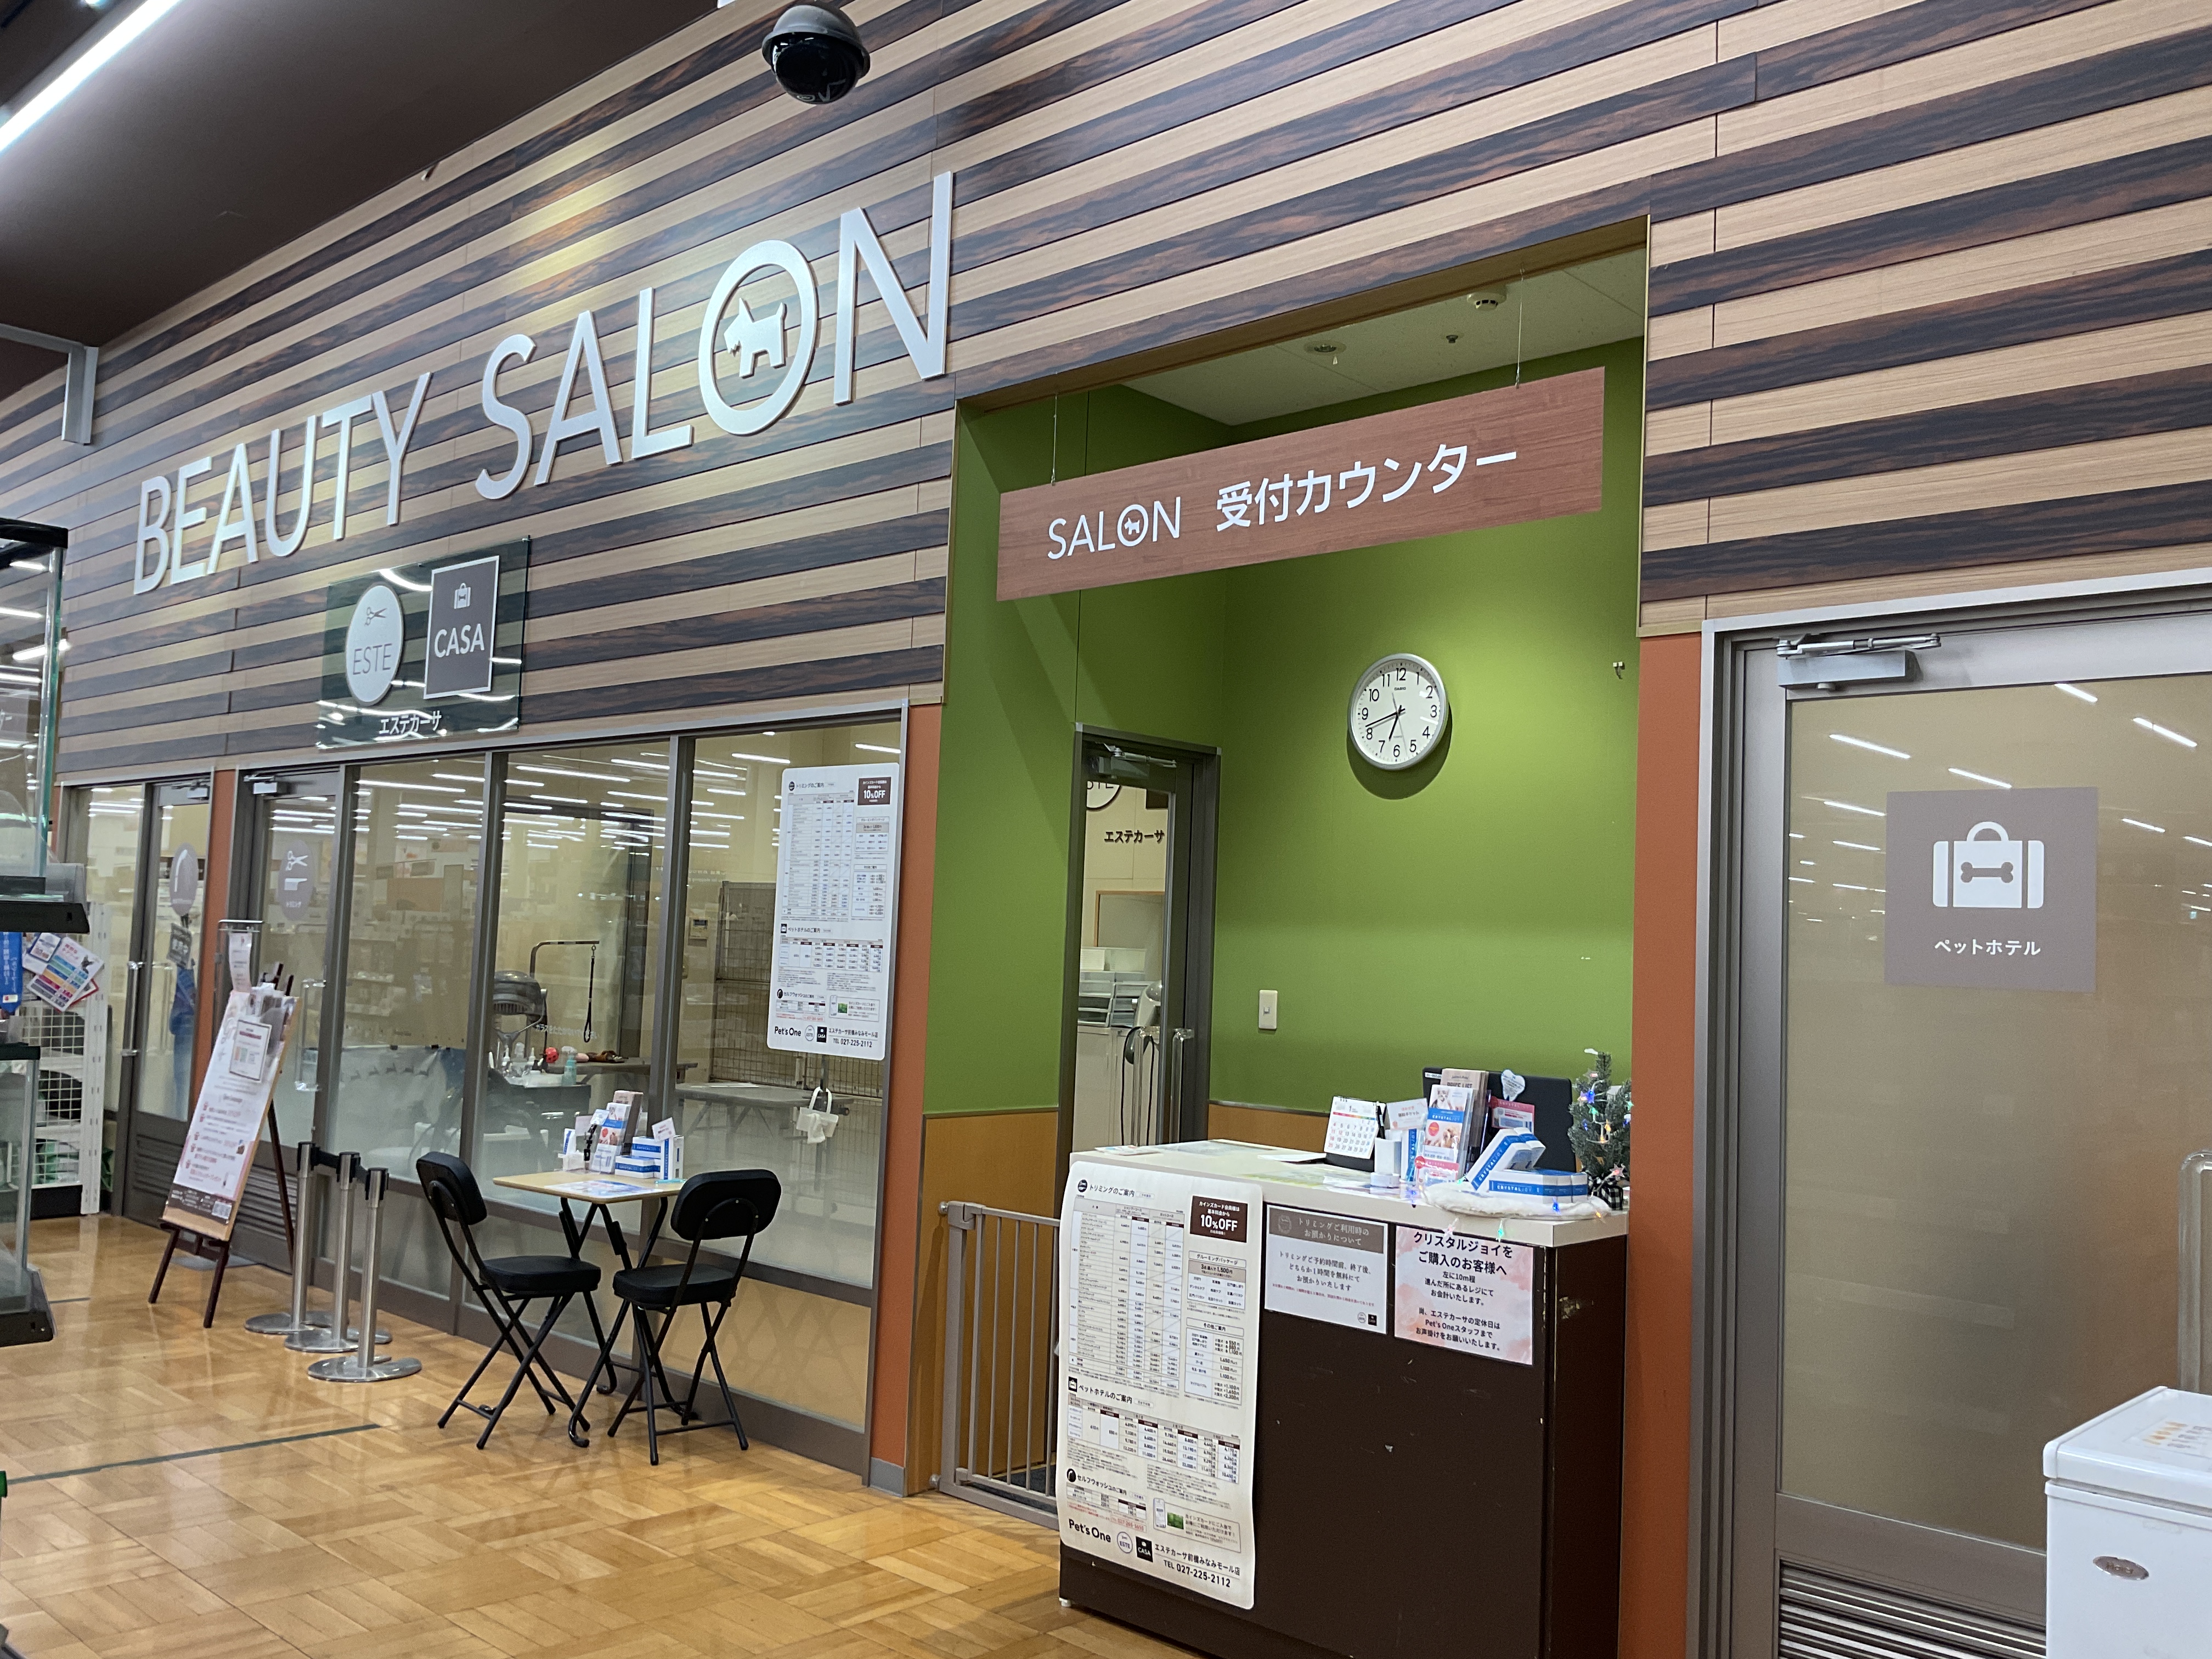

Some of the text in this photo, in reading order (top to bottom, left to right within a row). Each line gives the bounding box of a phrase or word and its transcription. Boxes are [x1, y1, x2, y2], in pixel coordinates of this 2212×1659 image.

[134, 171, 952, 595] BEAUTY SALON
[1047, 443, 1517, 560] SALON 受付カウンター
[435, 623, 485, 658] CASA
[353, 643, 393, 675] ESTE
[1383, 674, 1390, 687] 11
[1396, 668, 1406, 681] 12
[1417, 672, 1419, 685] 1
[1369, 689, 1379, 702] 10
[1426, 686, 1432, 698] 2
[1362, 708, 1368, 720] 9
[1431, 705, 1437, 718] 3
[379, 710, 441, 735] エステカーサ
[1367, 727, 1373, 740] 8
[1423, 726, 1430, 738] 4
[1379, 741, 1385, 753] 7
[1393, 744, 1400, 757] 6
[1410, 740, 1417, 752] 5
[864, 790, 885, 799] 10%OFF
[1104, 830, 1165, 843] エステカーサ
[1934, 939, 2040, 956] ペットホテル
[774, 1026, 802, 1036] Pet's One
[840, 1039, 872, 1048] 027-225-2112
[1090, 1184, 1135, 1197] トリミングのご案内
[1200, 1214, 1238, 1232] 10%OFF
[1299, 1217, 1369, 1235] トリミングご利用時の
[1304, 1229, 1362, 1246] お預かりについて
[1414, 1231, 1513, 1259] クリスタルジョイを
[1197, 1254, 1238, 1265] グルーミングパッケージ
[1280, 1250, 1372, 1274] トリミングご予約時間前、終了後、
[1419, 1250, 1507, 1276] ご購入のお客様へ
[1296, 1275, 1352, 1291] お預かりいたします
[1442, 1271, 1476, 1284] 左に10m程
[1424, 1277, 1494, 1297] 進んだ所にあるレジにて
[1431, 1289, 1484, 1306] お会計いたします。
[1419, 1307, 1500, 1330] 尚、エステカーサの定休日は
[1425, 1319, 1493, 1339] Pet's Oneスタッフまで
[1415, 1327, 1500, 1351] お声掛けをお願いいたします。
[1079, 1385, 1132, 1404] ペットホテルのご案内
[1077, 1474, 1127, 1496] セルフウォッシュのご案内
[1069, 1518, 1111, 1543] Pet's One
[1119, 1541, 1131, 1549] ESTE
[1138, 1547, 1152, 1556] CASA
[1155, 1543, 1240, 1576] エステカーサ前橋みなみモール店
[1163, 1560, 1231, 1588] TEL 027-225-2112
